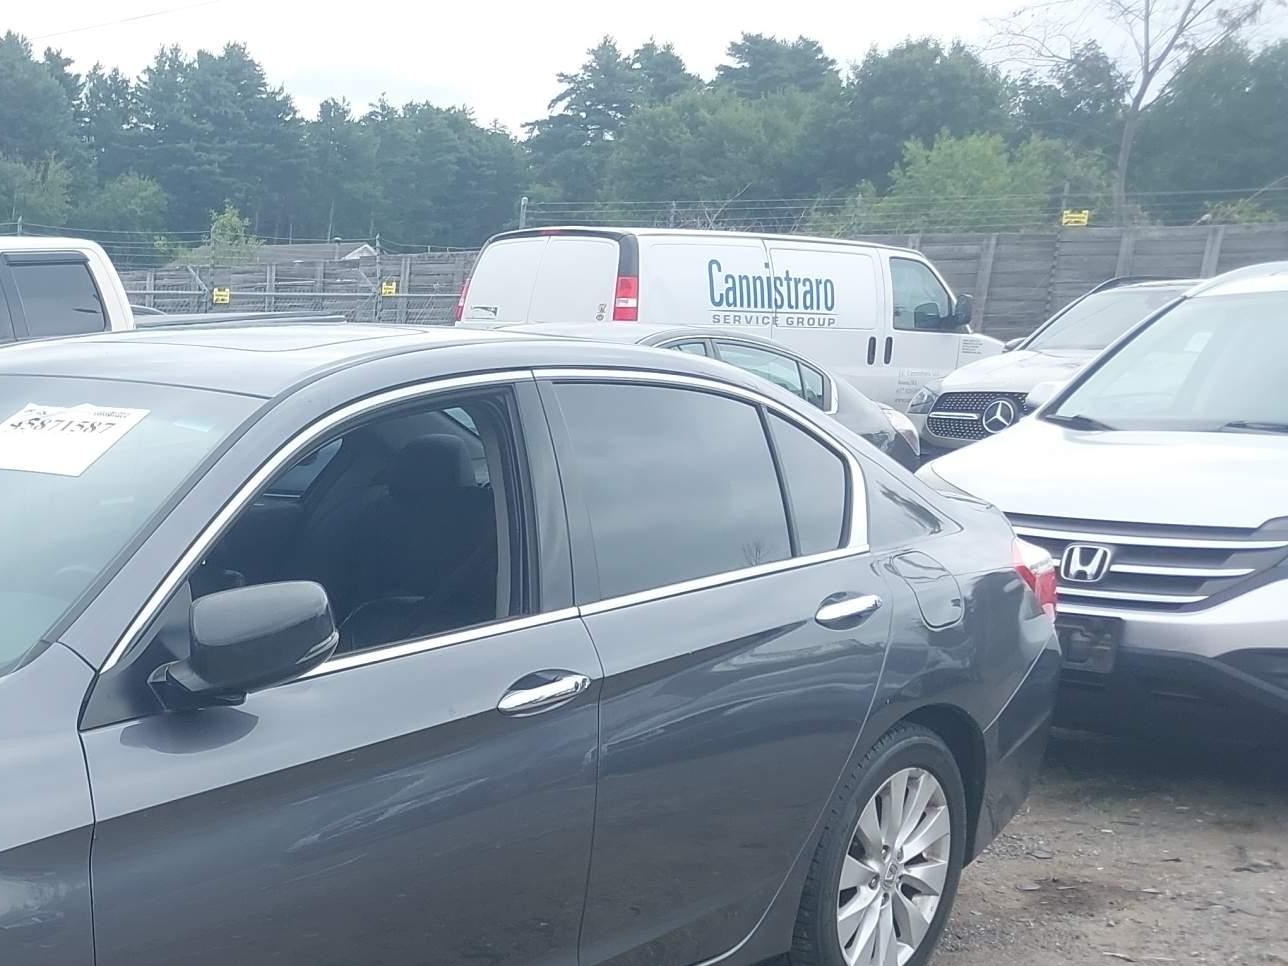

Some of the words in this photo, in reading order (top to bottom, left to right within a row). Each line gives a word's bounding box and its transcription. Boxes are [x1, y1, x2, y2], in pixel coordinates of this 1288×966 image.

[708, 259, 835, 311] Cannistraro
[712, 314, 779, 325] SERVICE
[786, 316, 835, 327] GROUP
